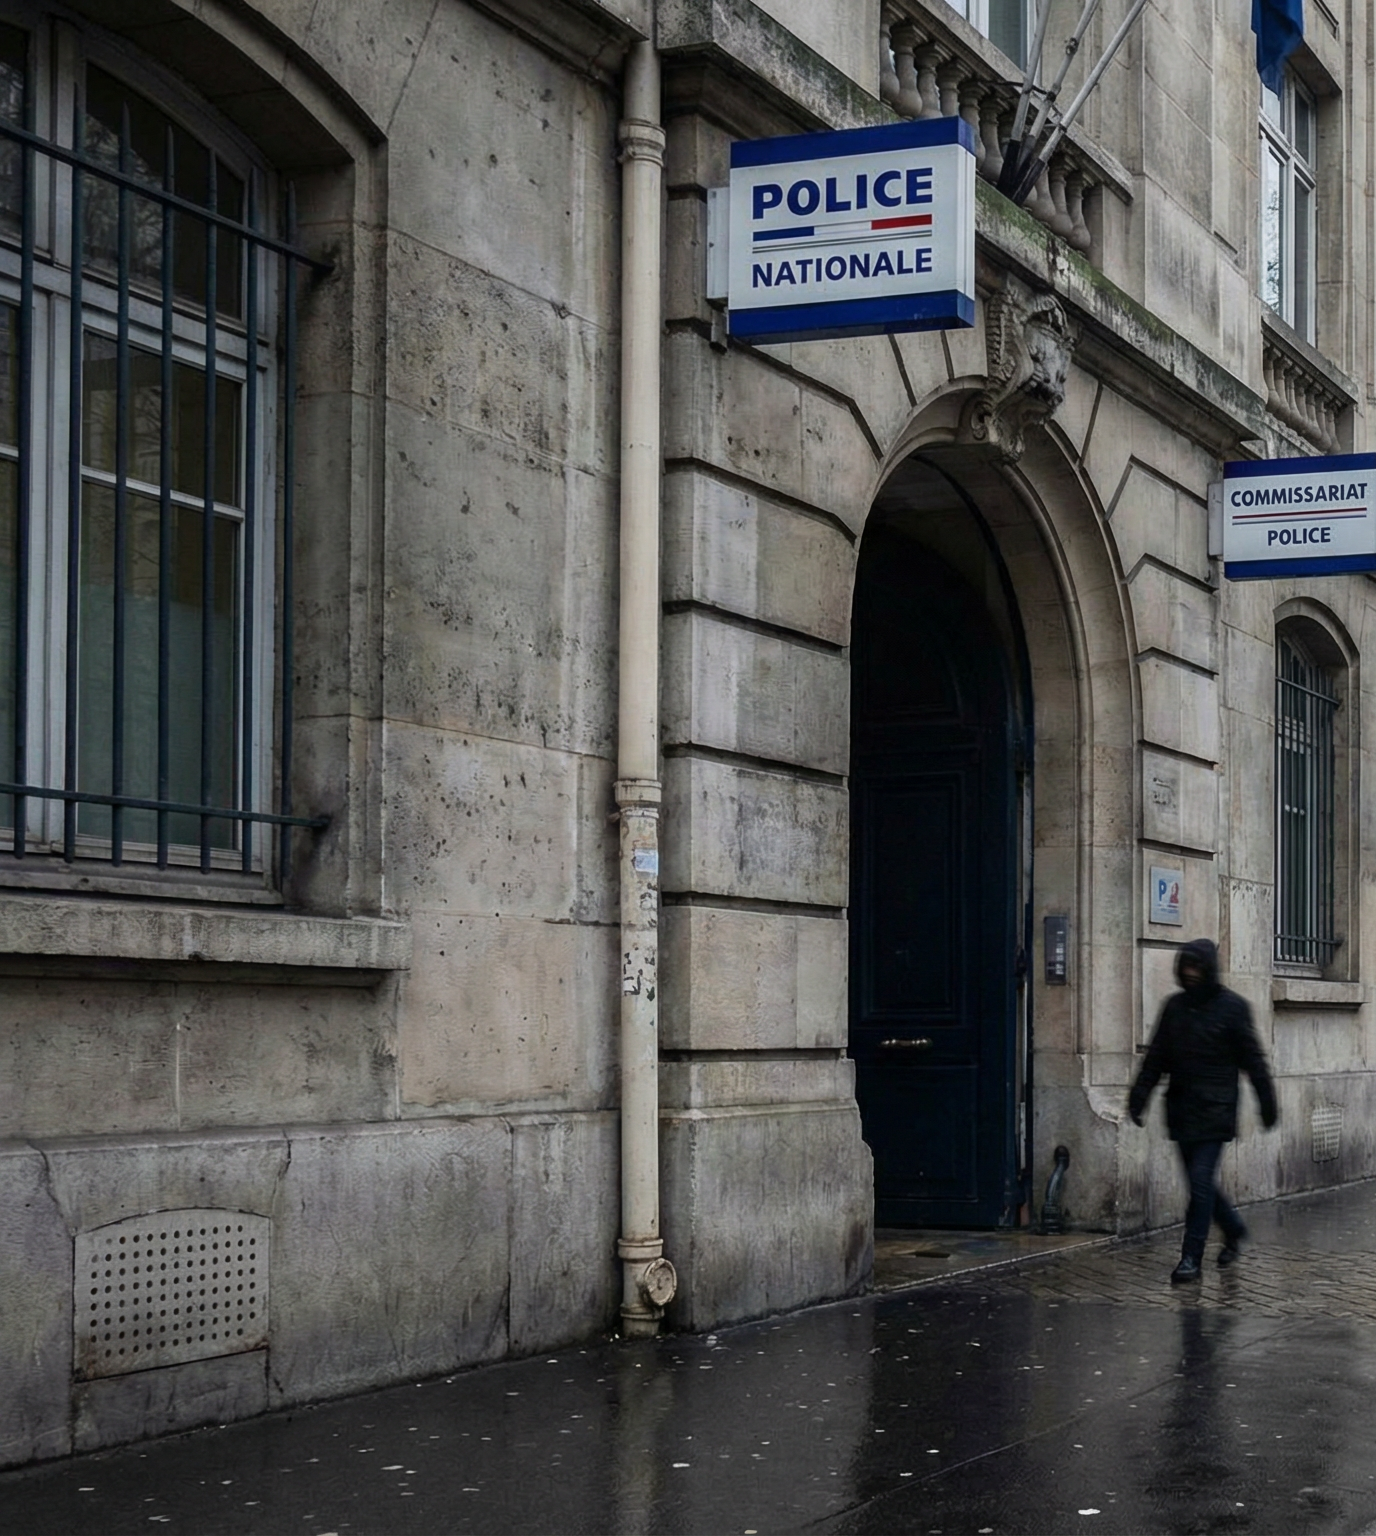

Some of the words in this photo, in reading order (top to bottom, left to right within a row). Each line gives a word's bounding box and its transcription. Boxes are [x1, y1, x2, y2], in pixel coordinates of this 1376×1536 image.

[752, 167, 932, 219] POLICE
[752, 248, 932, 288] NATIONALE
[1231, 483, 1367, 507] COMMISSARIAT
[1267, 527, 1331, 546] POLICE
